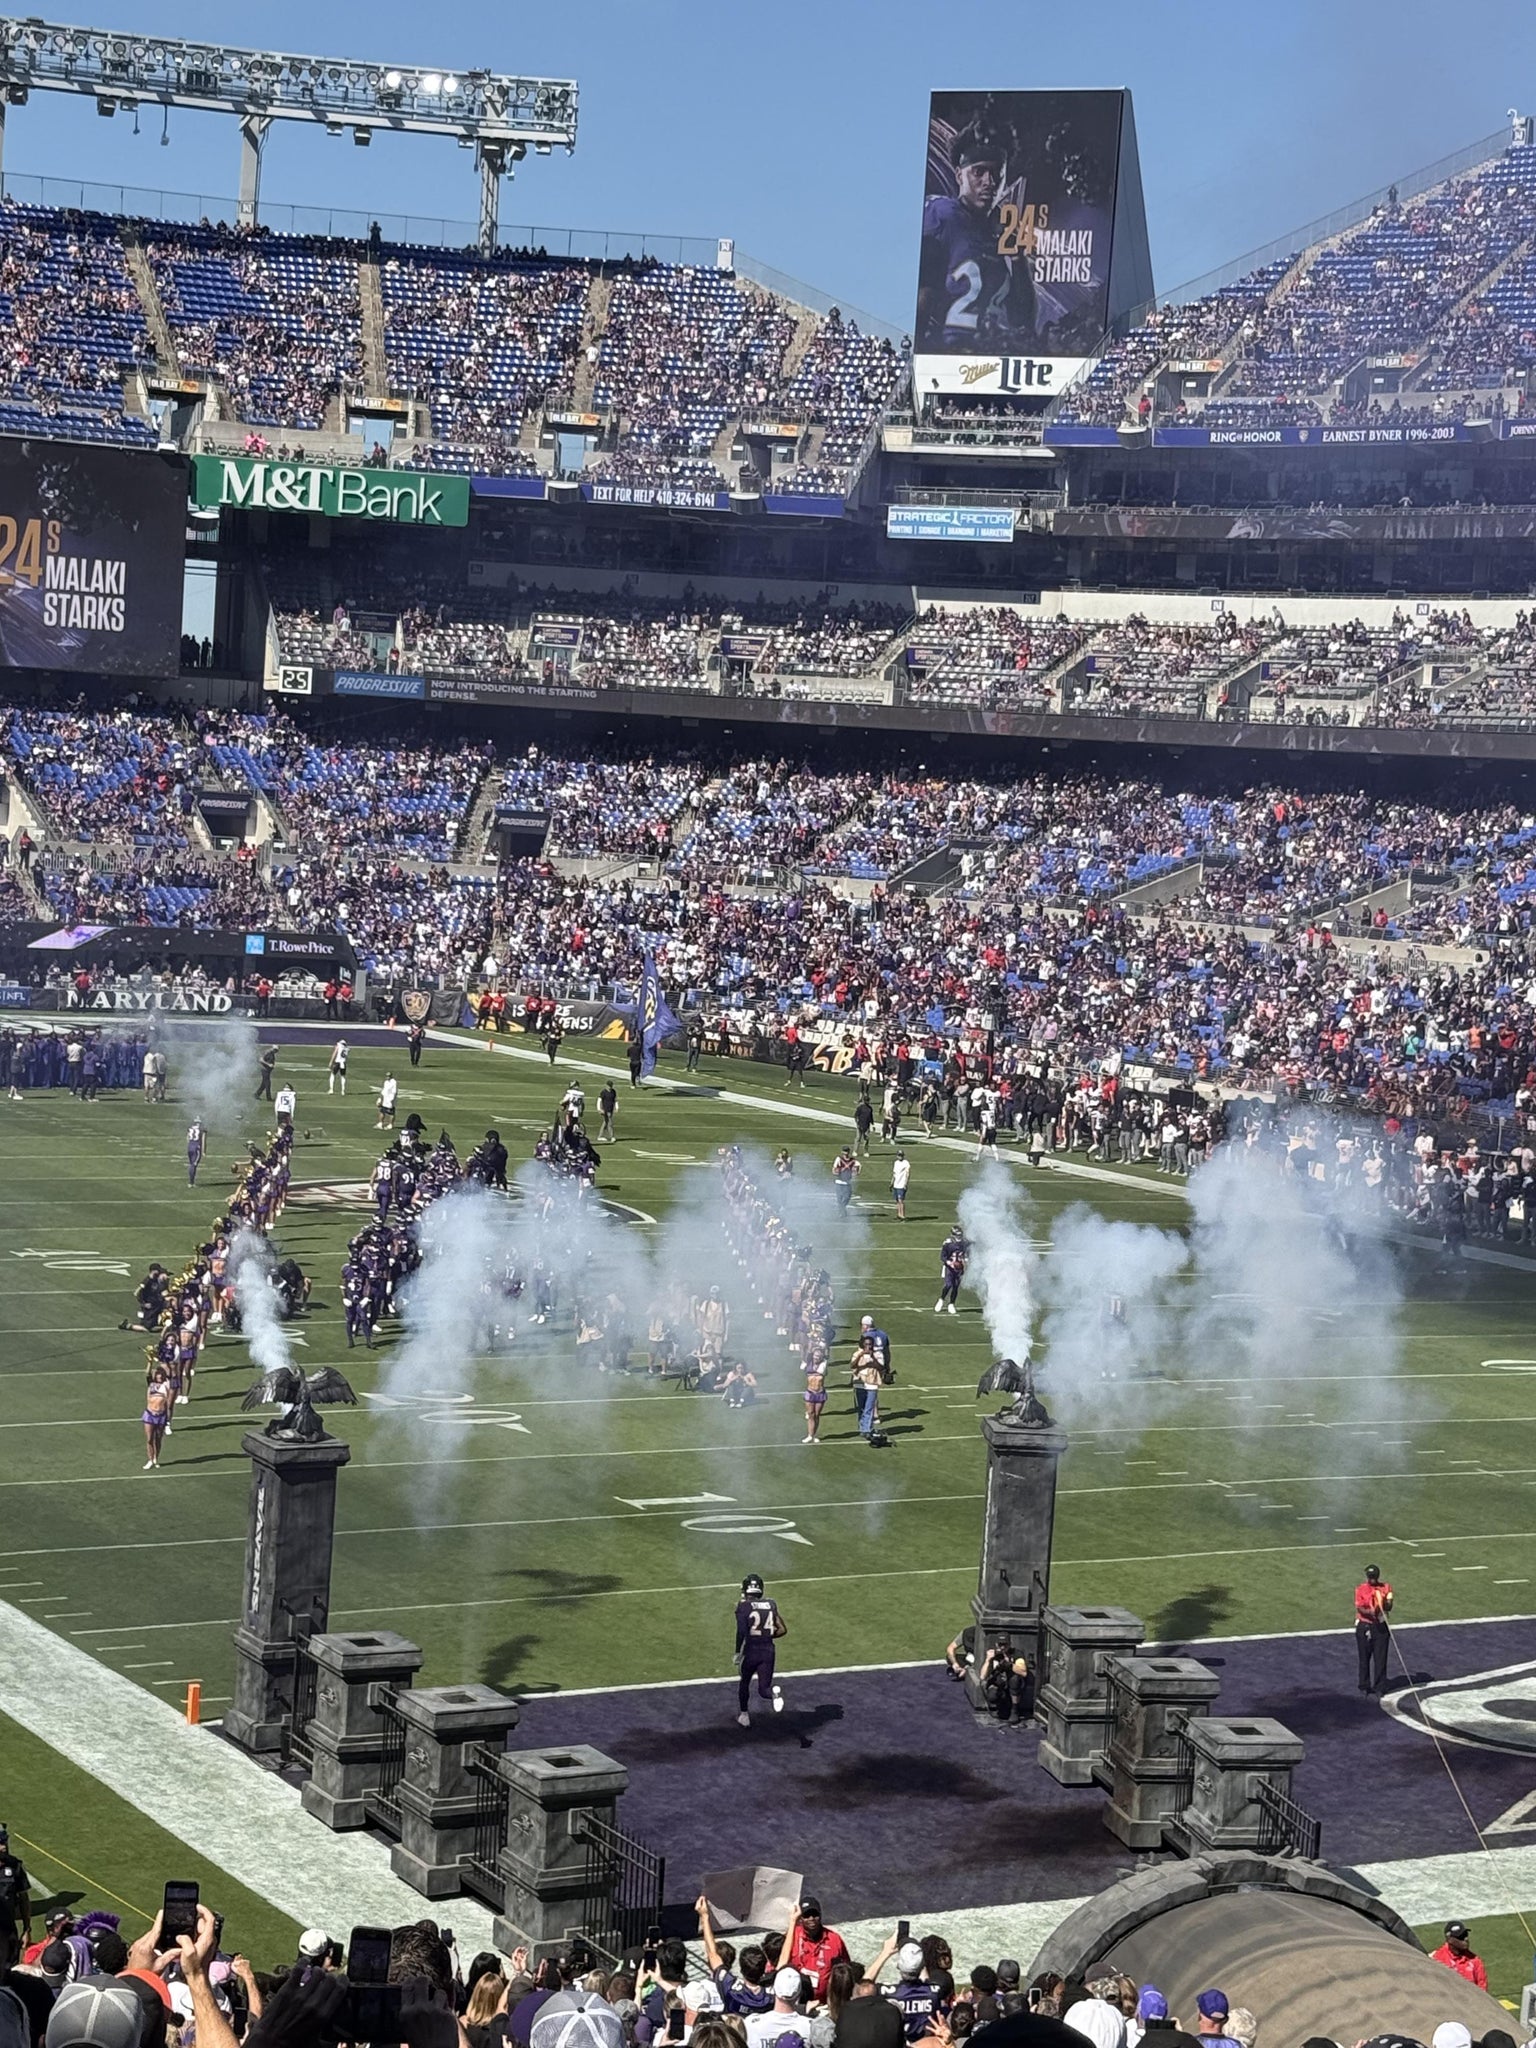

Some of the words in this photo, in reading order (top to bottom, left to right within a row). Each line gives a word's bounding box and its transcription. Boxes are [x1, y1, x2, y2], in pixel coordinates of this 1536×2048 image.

[997, 203, 1036, 255] 24
[1036, 229, 1092, 255] MALAKI
[1034, 256, 1091, 283] STARKS
[998, 357, 1052, 394] Lite
[1210, 431, 1236, 442] RING
[1243, 431, 1282, 442] HONOR
[1322, 430, 1367, 442] EARNEST
[1369, 429, 1402, 441] BYNER
[1405, 427, 1454, 441] 1996-2003
[218, 460, 334, 513] M&T
[337, 471, 443, 522] Bank
[592, 485, 613, 501] TEXT
[615, 488, 632, 502] FOR
[633, 489, 655, 504] HELP
[656, 491, 715, 508] 410-324-6141
[960, 513, 1013, 524] FACTORY
[46, 520, 61, 554] S
[45, 554, 126, 596] MALAKI
[43, 592, 125, 632] STARKS
[283, 670, 307, 689] 25
[335, 676, 423, 695] PROGRESSIVE
[431, 679, 456, 689] NOW
[457, 682, 525, 695] INTRODUCING
[527, 686, 547, 696] THE
[549, 688, 598, 699] STARTING
[430, 690, 478, 701] DEFENSE.
[749, 1610, 777, 1636] 24
